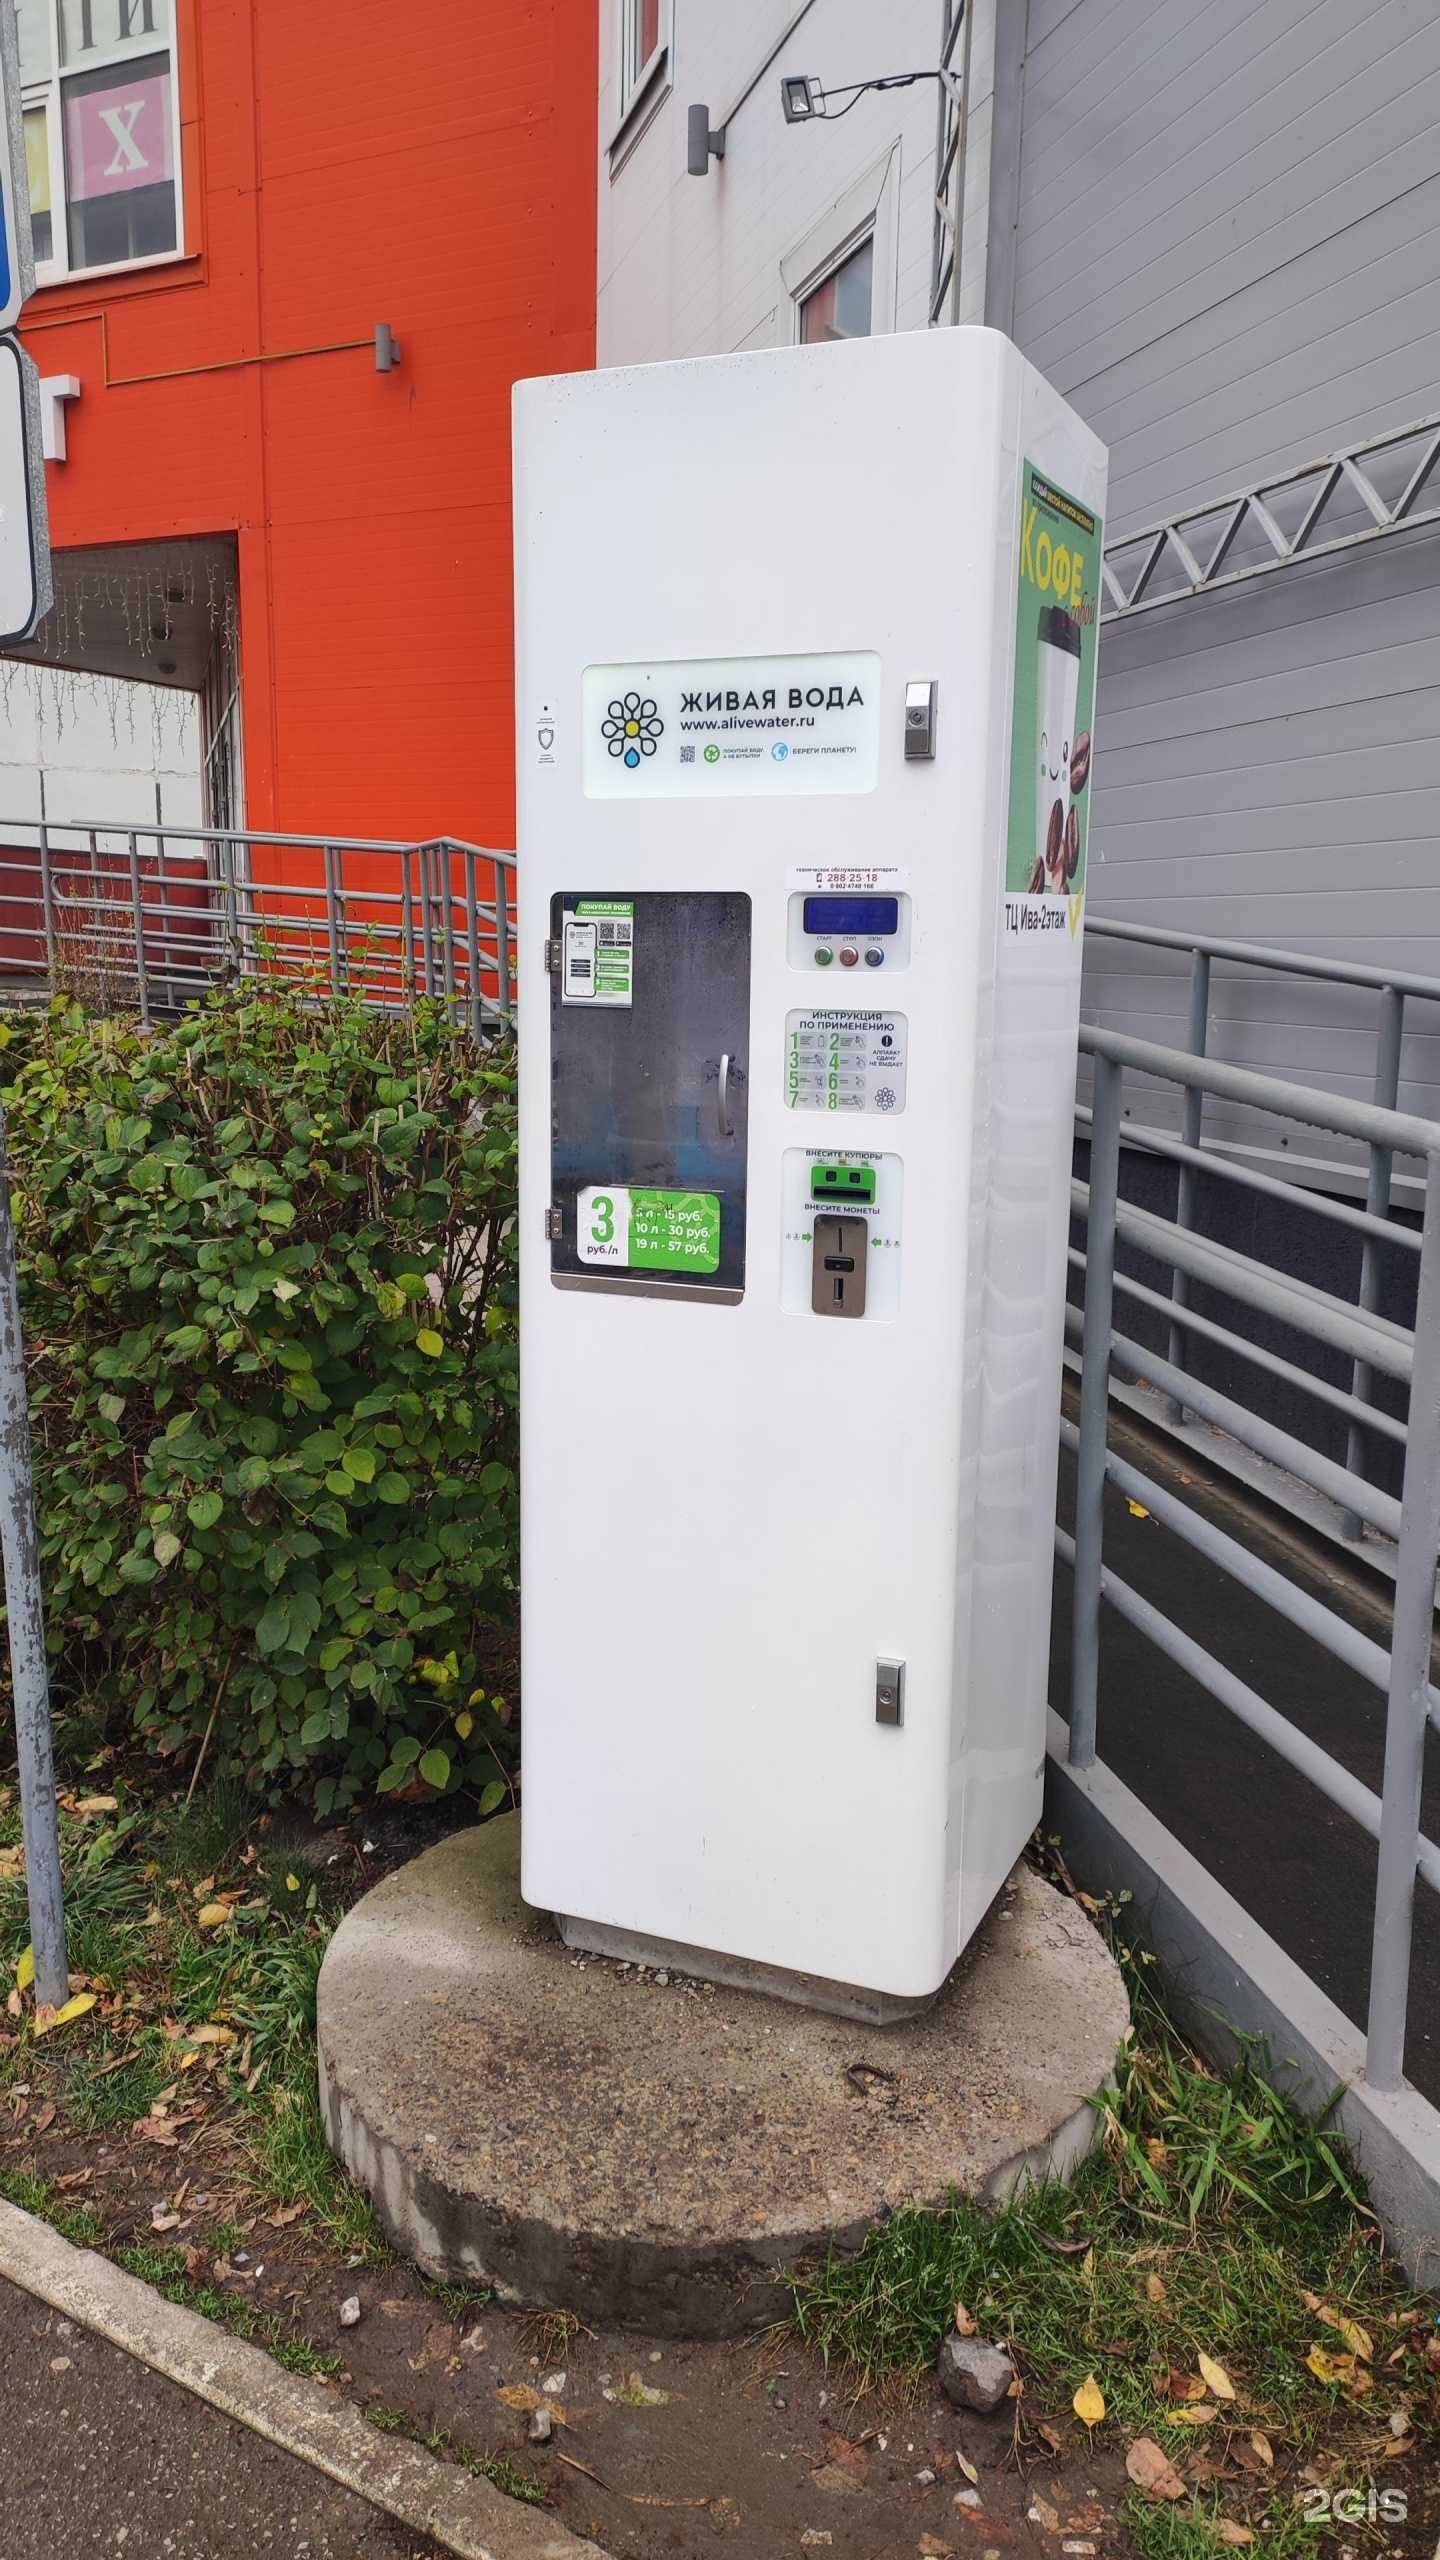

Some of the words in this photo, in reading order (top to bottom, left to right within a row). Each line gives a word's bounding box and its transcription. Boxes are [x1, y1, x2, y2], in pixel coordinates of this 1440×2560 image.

[680, 689, 776, 712] ЖИВАЯ
[789, 686, 864, 711] ВОДА
[680, 716, 815, 731] www.alivewater.ru
[792, 747, 820, 755] БЕРЕГИ
[1005, 904, 1018, 935] ТЦ
[812, 1011, 882, 1021] ИНСТРУКЦИЯ
[799, 1021, 815, 1029] ПО
[817, 1022, 894, 1031] ПРИМЕНЕНИЮ
[790, 1032, 798, 1049] 1
[830, 1033, 839, 1050] 2
[790, 1052, 799, 1069] 3
[829, 1053, 839, 1071] 4
[789, 1072, 799, 1088] 5
[828, 1073, 838, 1090] 6
[789, 1091, 799, 1108] 7
[828, 1092, 837, 1110] 8
[805, 1150, 843, 1158] ВНЕСИТЕ
[845, 1152, 883, 1160] КУПЮРЫ
[678, 1211, 703, 1223] руб.
[804, 1204, 842, 1212] ВНЕСИТЕ
[844, 1206, 880, 1215] МОНЕТЫ
[591, 1195, 615, 1243] 3
[636, 1222, 648, 1233] 10
[651, 1225, 659, 1234] л
[668, 1225, 683, 1236] 30
[687, 1227, 711, 1239] руб.
[635, 1238, 648, 1249] 19
[650, 1241, 658, 1250] л
[668, 1241, 682, 1251] 57
[685, 1243, 710, 1255] руб.
